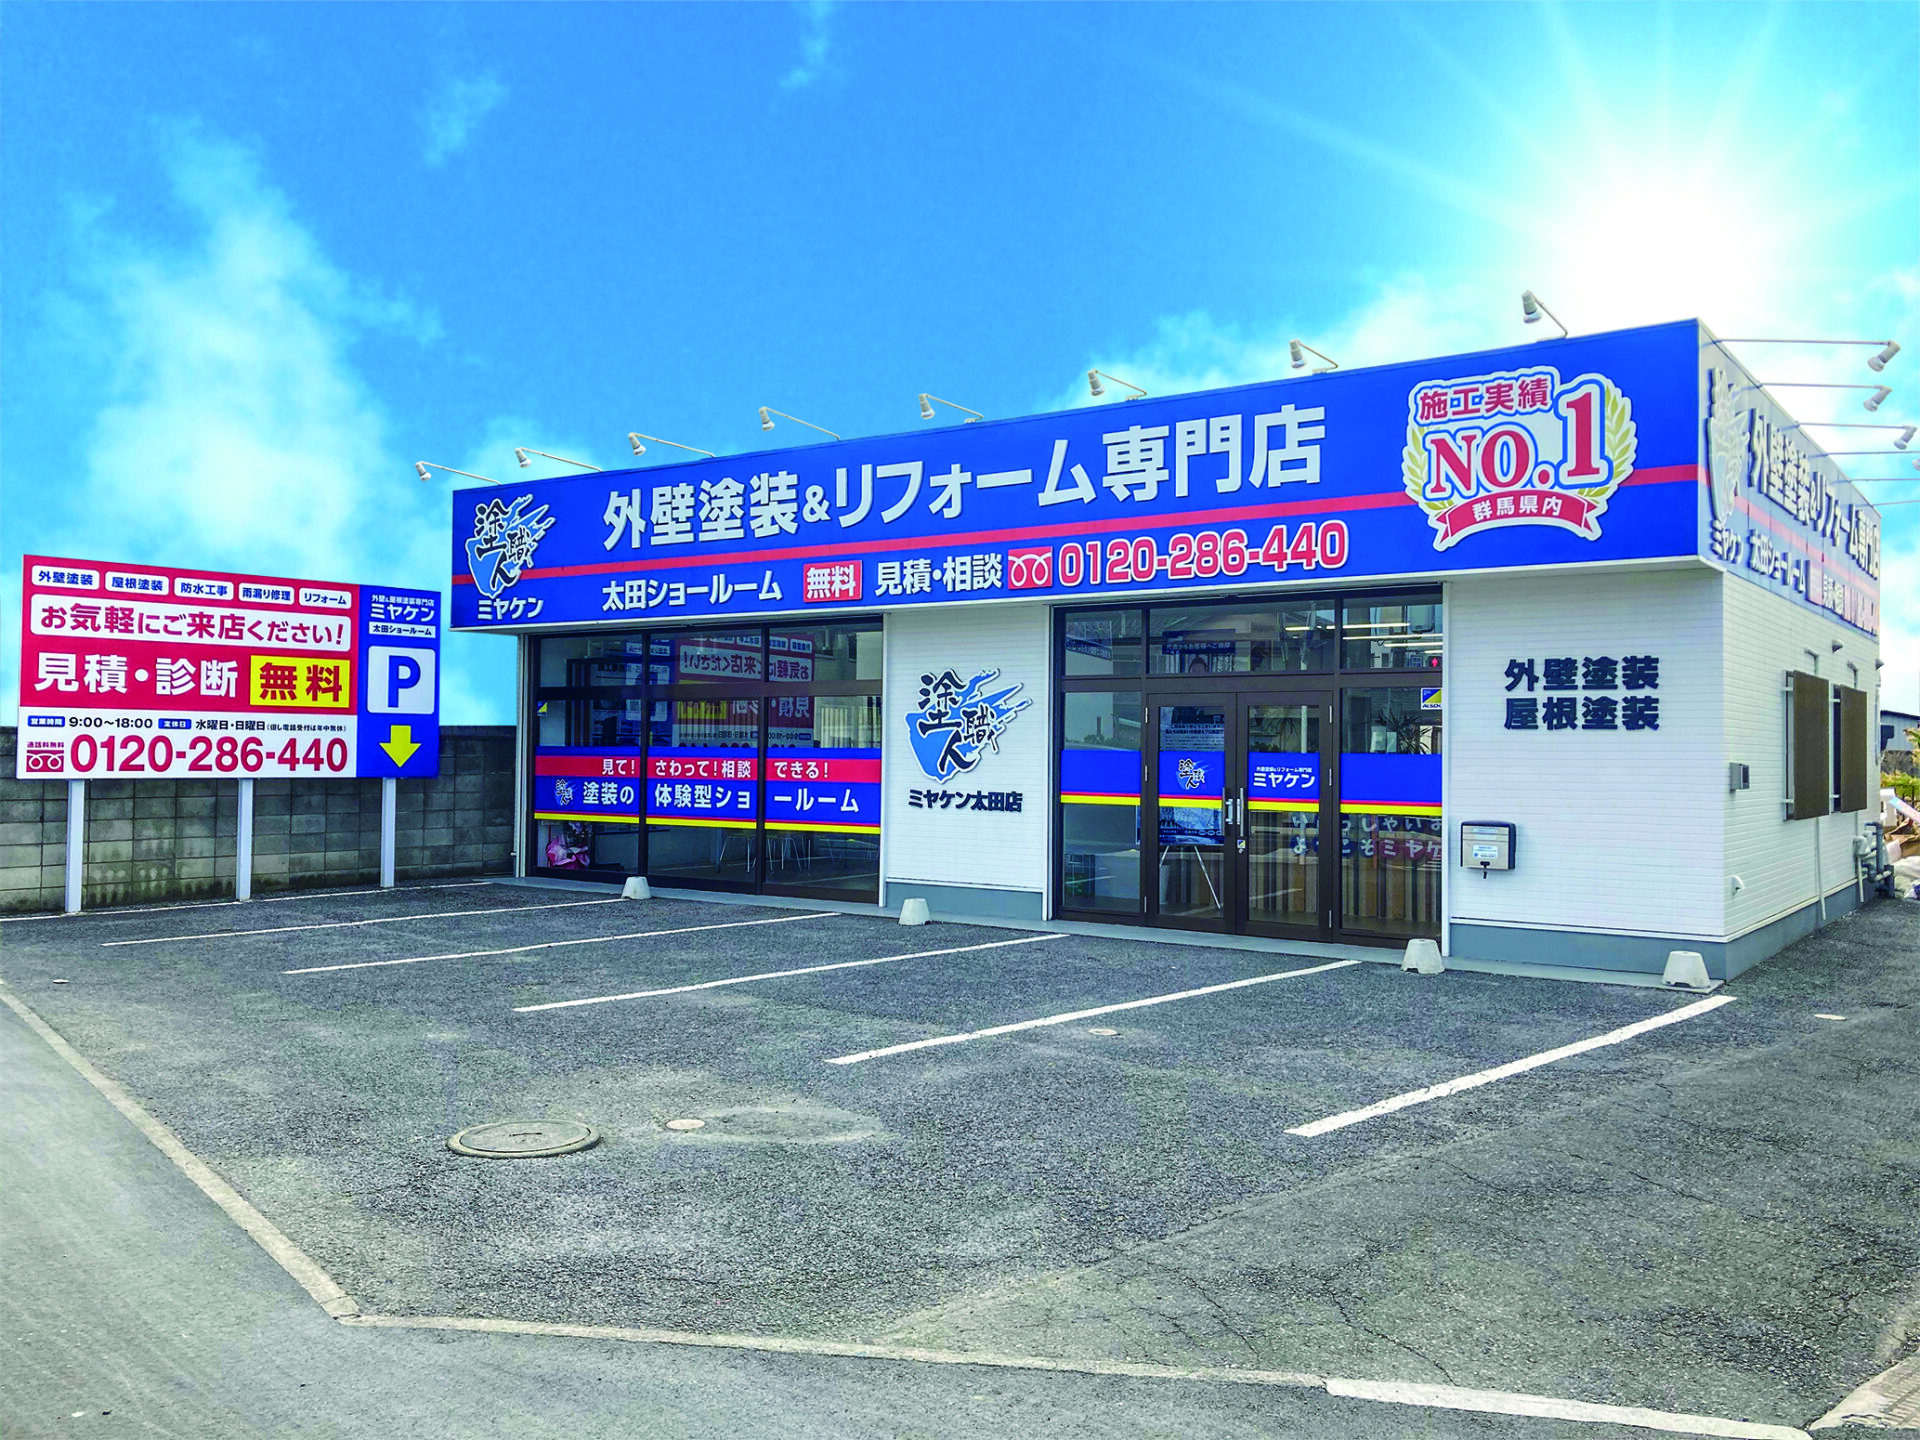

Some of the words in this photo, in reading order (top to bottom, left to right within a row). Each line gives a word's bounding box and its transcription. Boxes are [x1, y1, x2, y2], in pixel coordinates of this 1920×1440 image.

[1419, 376, 1549, 421] 施工実績
[1429, 390, 1601, 494] NO.1
[603, 403, 1326, 551] 外壁塗装&リフォーム専門店
[1471, 494, 1563, 522] 群馬県内
[38, 569, 94, 586] 外壁塗装
[602, 570, 784, 612] 太田ショールーム
[805, 566, 857, 599] 無料
[874, 553, 1003, 596] 見積・相談
[1057, 519, 1350, 589] 0120-286-440
[111, 576, 164, 592] 屋根塗装
[180, 582, 229, 597] 防水工事
[242, 586, 292, 602] 雨漏り修理
[303, 592, 347, 605] リフォーム
[477, 596, 545, 621] ミヤケン
[41, 602, 344, 646] お気軽にご来店ください!
[370, 603, 435, 622] ミヤケン
[372, 623, 432, 636] 太田ショールーム
[34, 651, 238, 698] 見積・診断
[259, 662, 343, 702] 無料
[387, 655, 421, 708] P
[1504, 655, 1660, 692] 外壁塗装
[163, 720, 187, 729] 定休日
[195, 719, 266, 730] 水曜日・日曜日
[1504, 697, 1660, 731] 屋根塗装
[70, 733, 348, 773] 0120-286-440
[601, 758, 636, 776] 見て!
[773, 761, 829, 779] できる!
[1252, 771, 1316, 789] ミヤケン
[582, 780, 635, 805] 塗装の
[908, 788, 1024, 813] ミヤケン太田店
